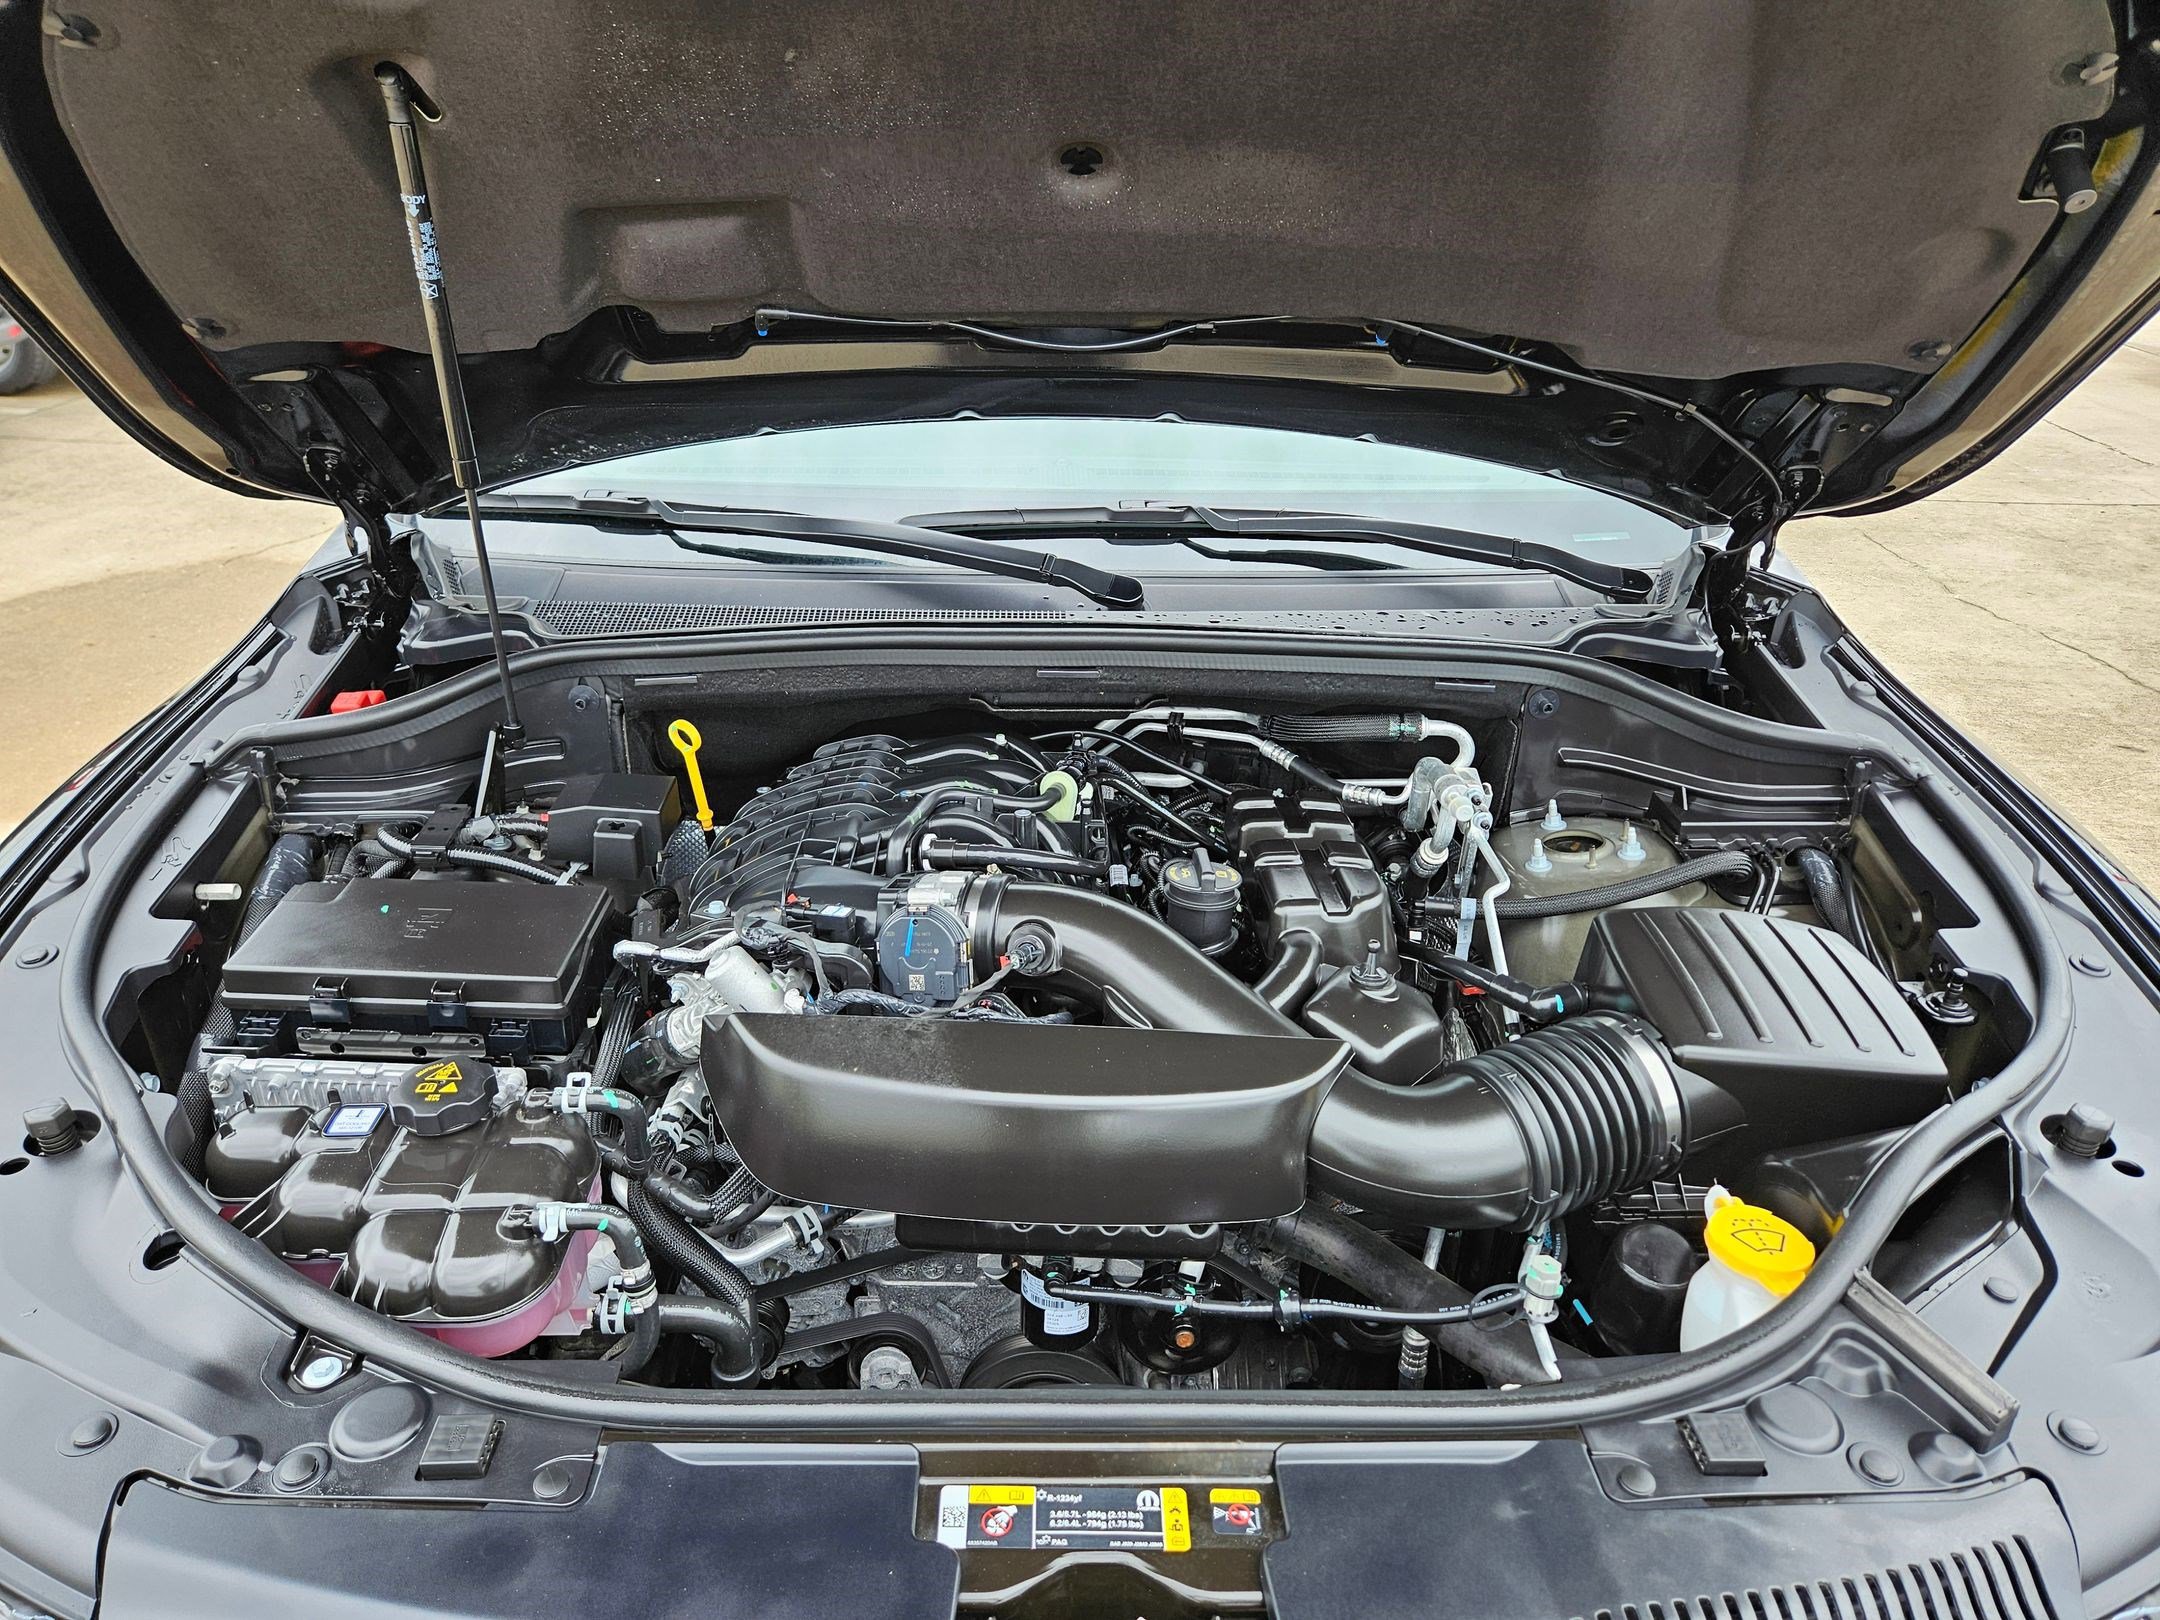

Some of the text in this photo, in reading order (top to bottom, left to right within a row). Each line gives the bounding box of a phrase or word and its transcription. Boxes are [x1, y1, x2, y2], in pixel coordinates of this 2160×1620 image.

[1047, 1494, 1083, 1504] R-1234yf
[1127, 1511, 1144, 1520] lbs)
[1127, 1520, 1145, 1530] lbs)
